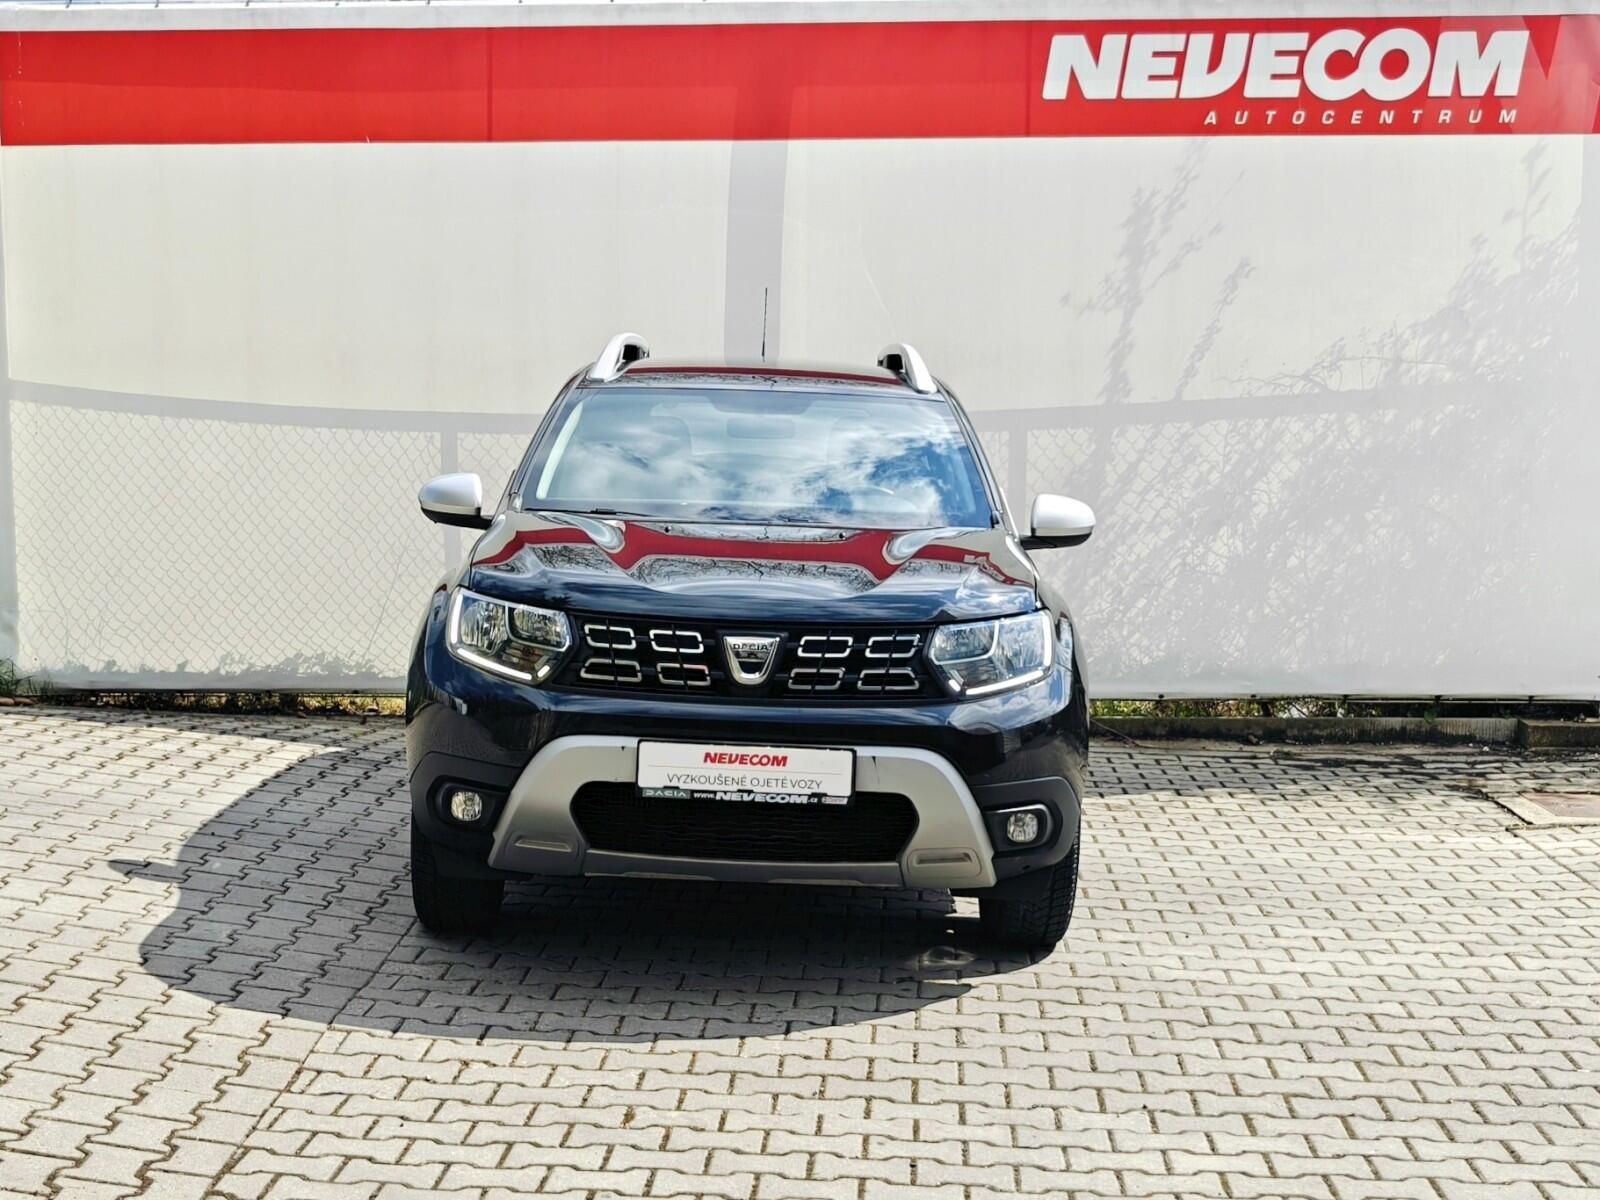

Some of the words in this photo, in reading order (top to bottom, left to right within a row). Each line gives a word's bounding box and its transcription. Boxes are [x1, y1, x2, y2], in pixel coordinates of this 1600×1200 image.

[1042, 28, 1530, 101] NEVECOM
[1203, 109, 1518, 126] AUTOCENTRUM
[732, 643, 769, 651] DACIA
[703, 752, 789, 767] NEVECOM
[666, 773, 747, 787] VYZKOUŠENÉ
[750, 776, 788, 788] OJETÉ
[789, 778, 823, 790] VOZY
[645, 789, 687, 798] DACIA
